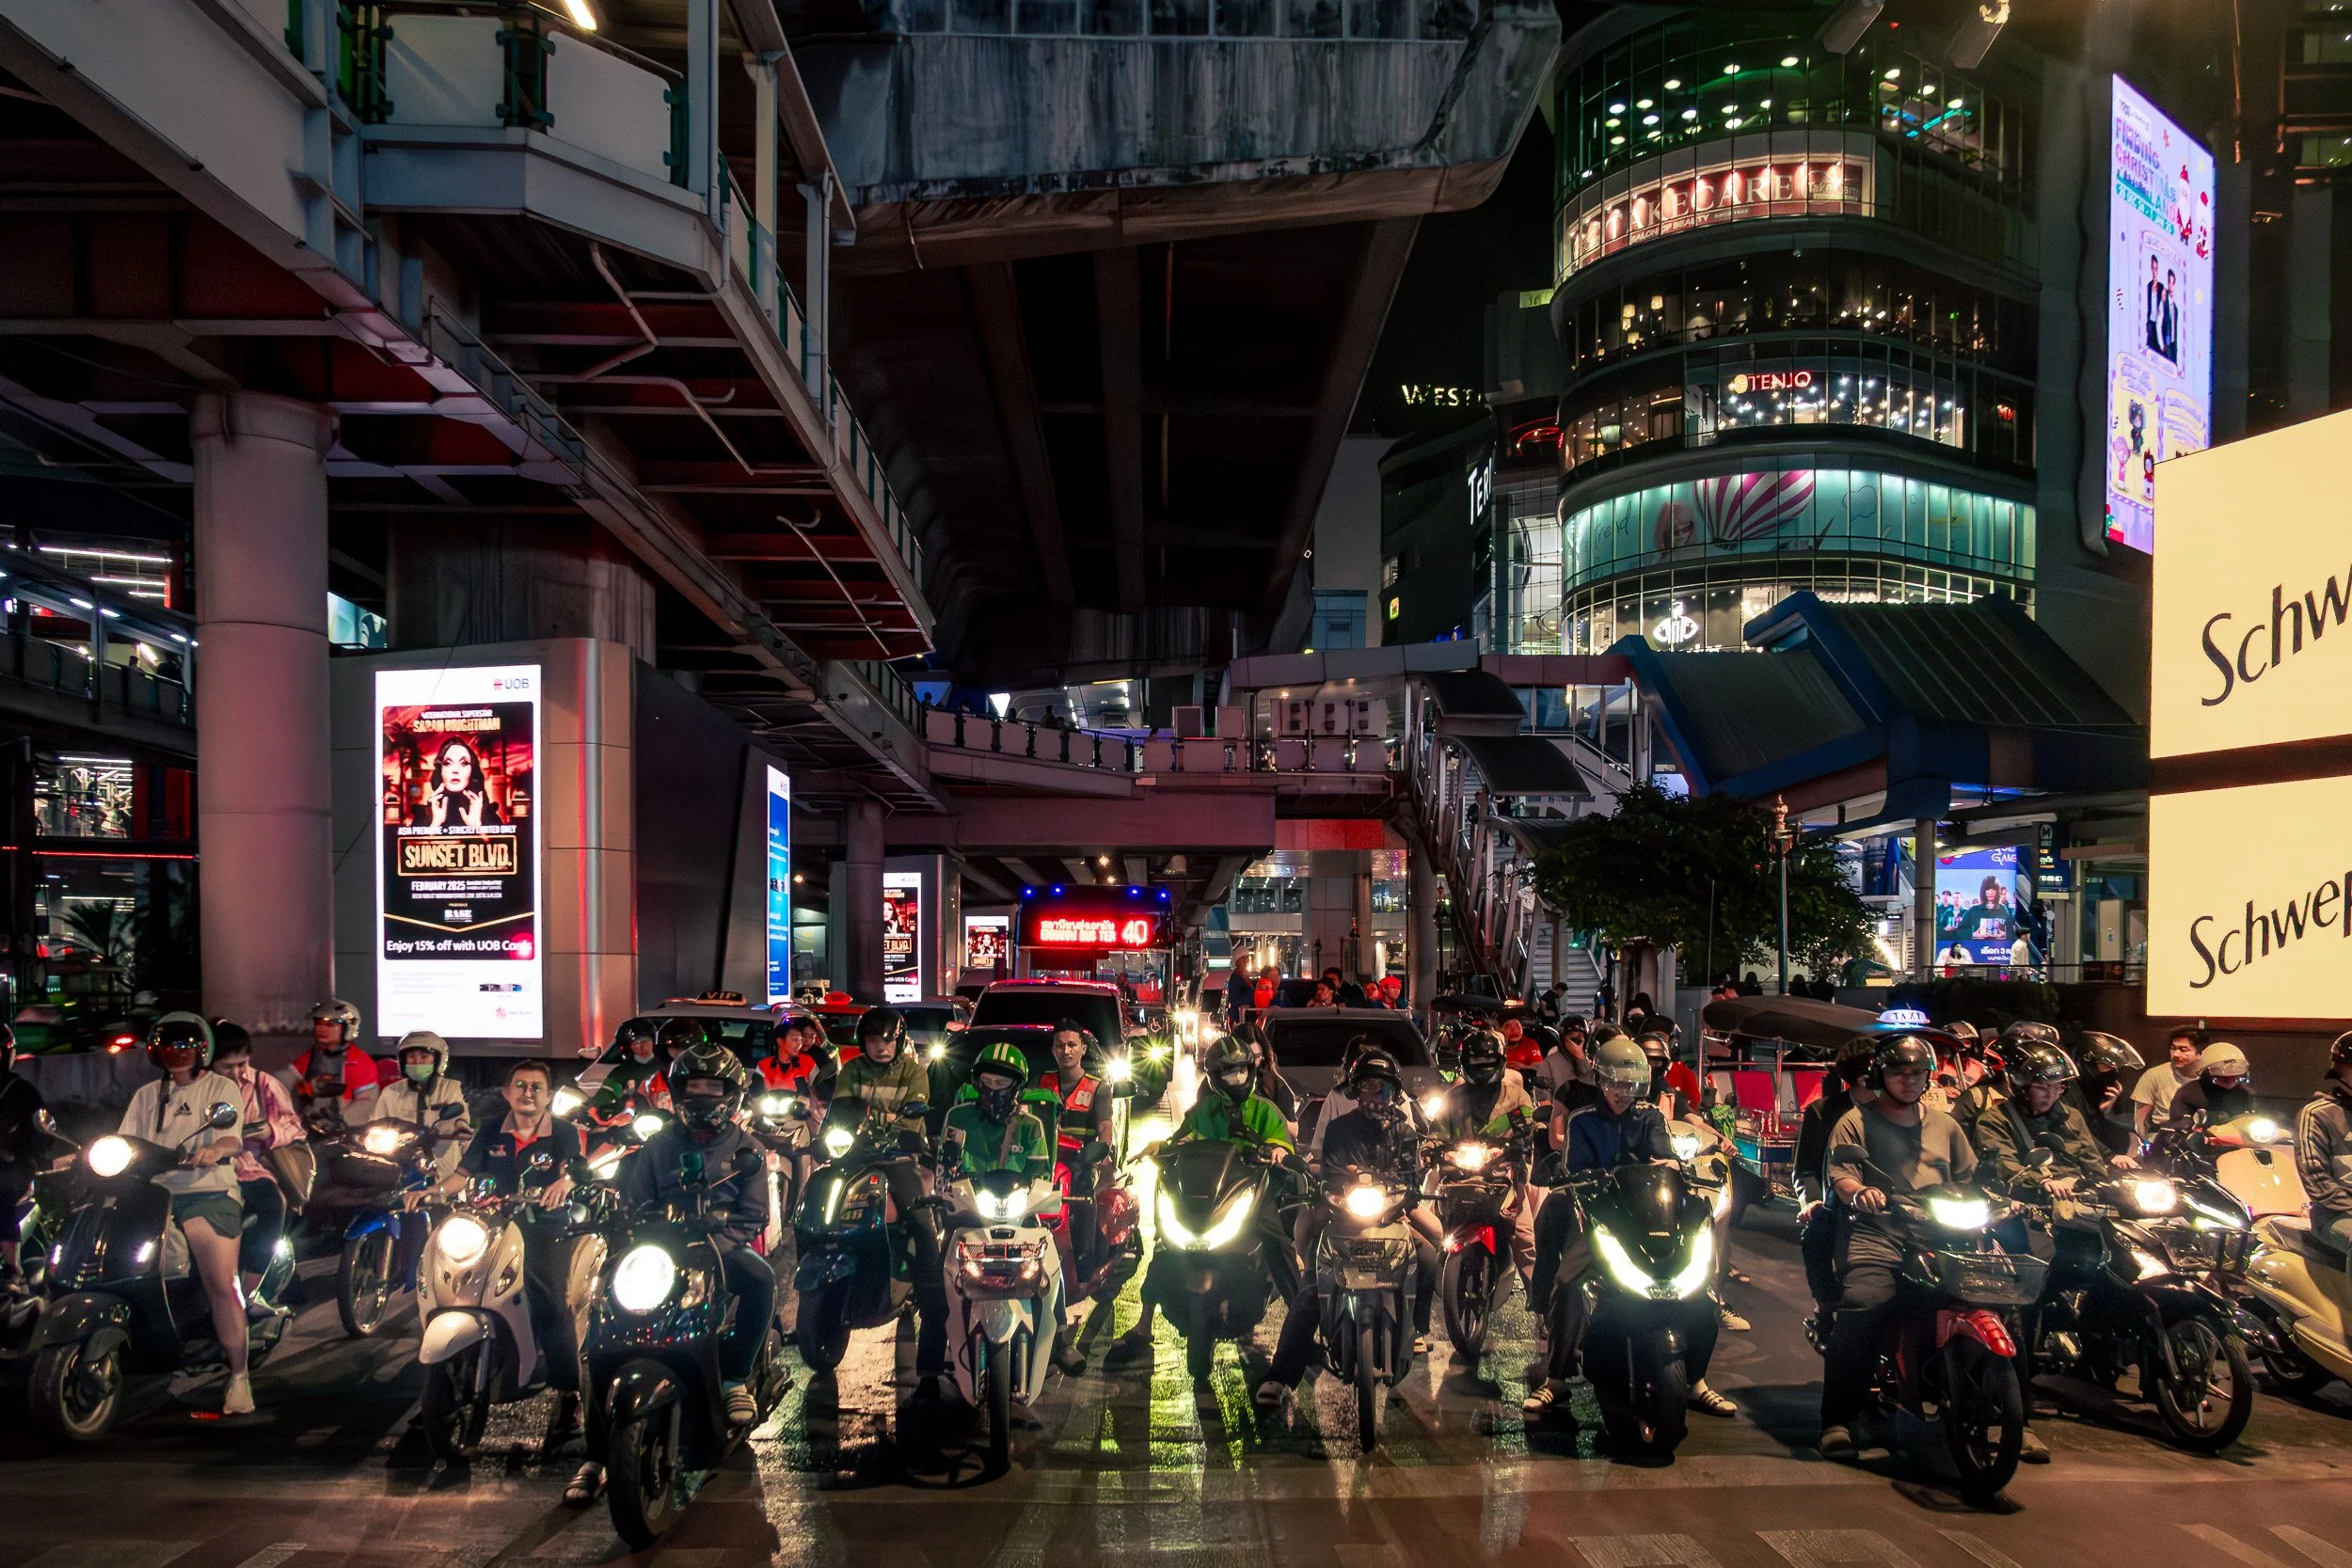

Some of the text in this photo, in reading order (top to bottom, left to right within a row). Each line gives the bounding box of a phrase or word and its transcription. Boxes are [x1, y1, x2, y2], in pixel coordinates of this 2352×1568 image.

[2201, 562, 2352, 707] Schw
[504, 678, 530, 690] UOB
[405, 843, 513, 868] SUNSET BLVD.
[411, 880, 447, 892] FEBRUARY
[1121, 919, 1148, 944] 40
[387, 940, 414, 954] Enjoy
[414, 941, 435, 951] 15%
[437, 940, 453, 951] off
[453, 940, 476, 951] with
[477, 941, 501, 951] UOB
[1892, 1012, 1921, 1021] TAXI
